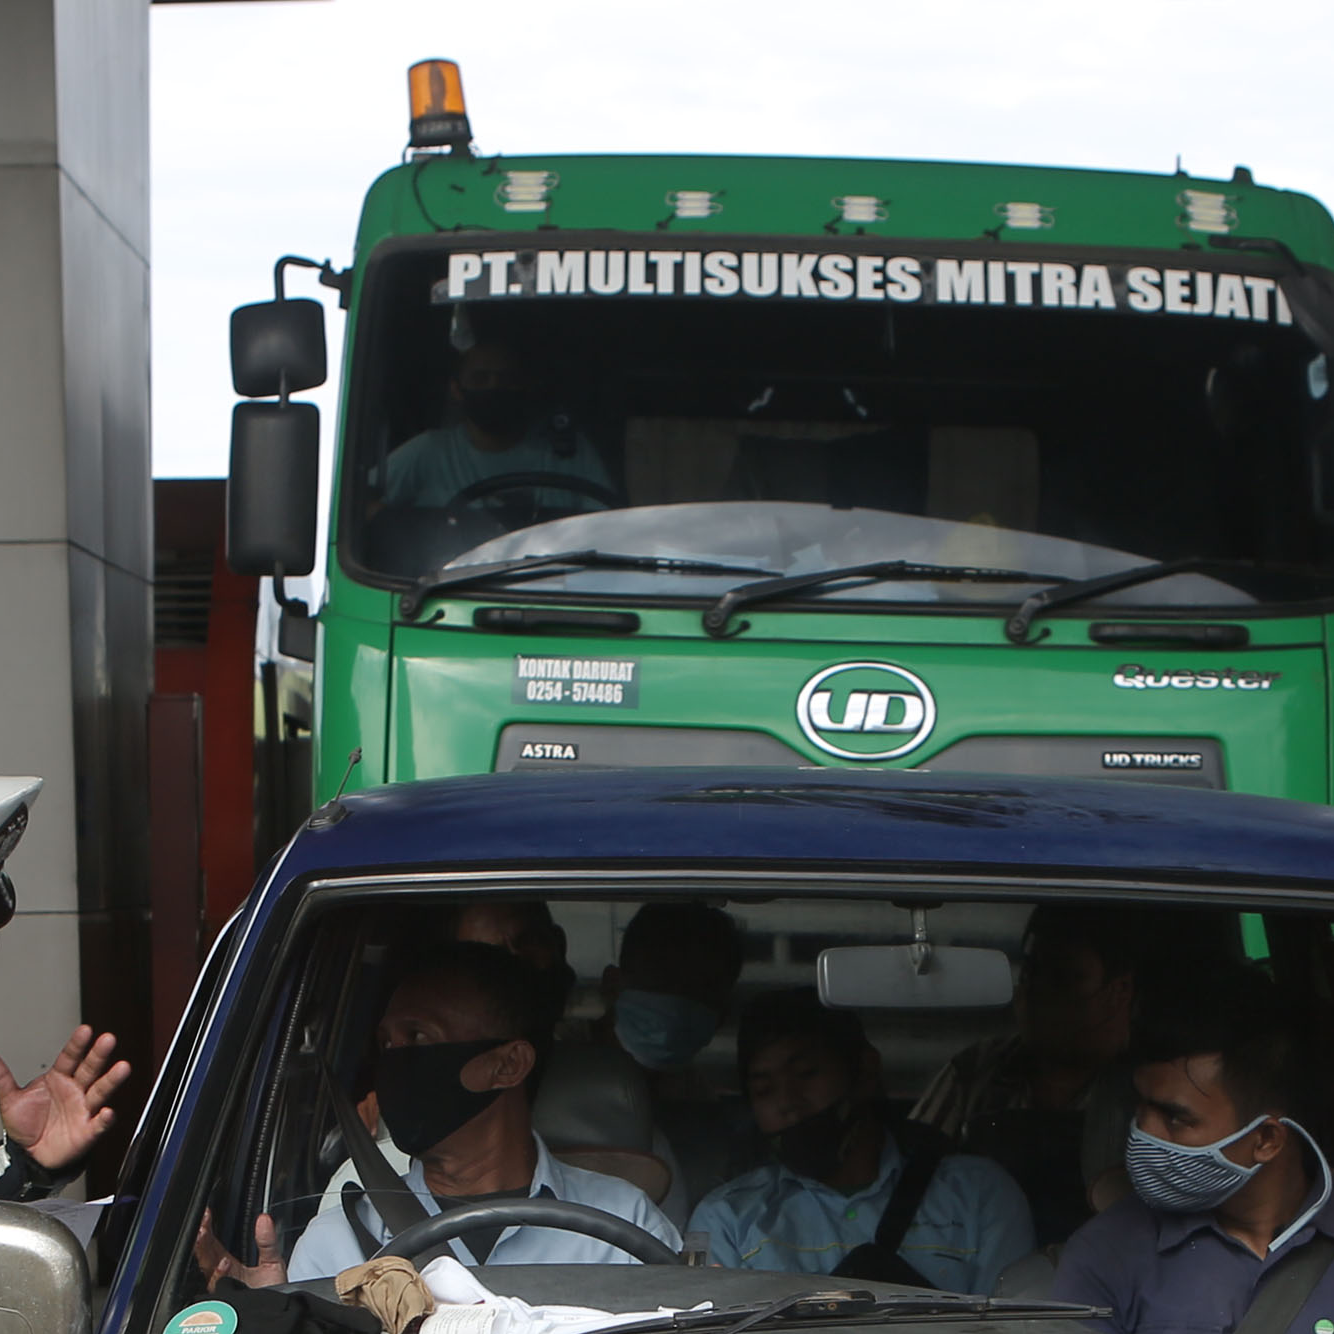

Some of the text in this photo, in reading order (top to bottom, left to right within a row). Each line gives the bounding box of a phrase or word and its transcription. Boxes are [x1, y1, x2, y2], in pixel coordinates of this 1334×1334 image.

[448, 251, 522, 298] PT.
[535, 250, 922, 301] MULTISUKSES
[936, 258, 1116, 308] MITRA
[519, 658, 635, 681] KONTAK DARURAT
[1113, 664, 1282, 689] Quester
[527, 681, 563, 701] 0254
[572, 682, 623, 704] 574486
[809, 691, 924, 732] UD
[522, 744, 575, 759] ASTRA
[1103, 753, 1202, 768] UD TRUCKS
